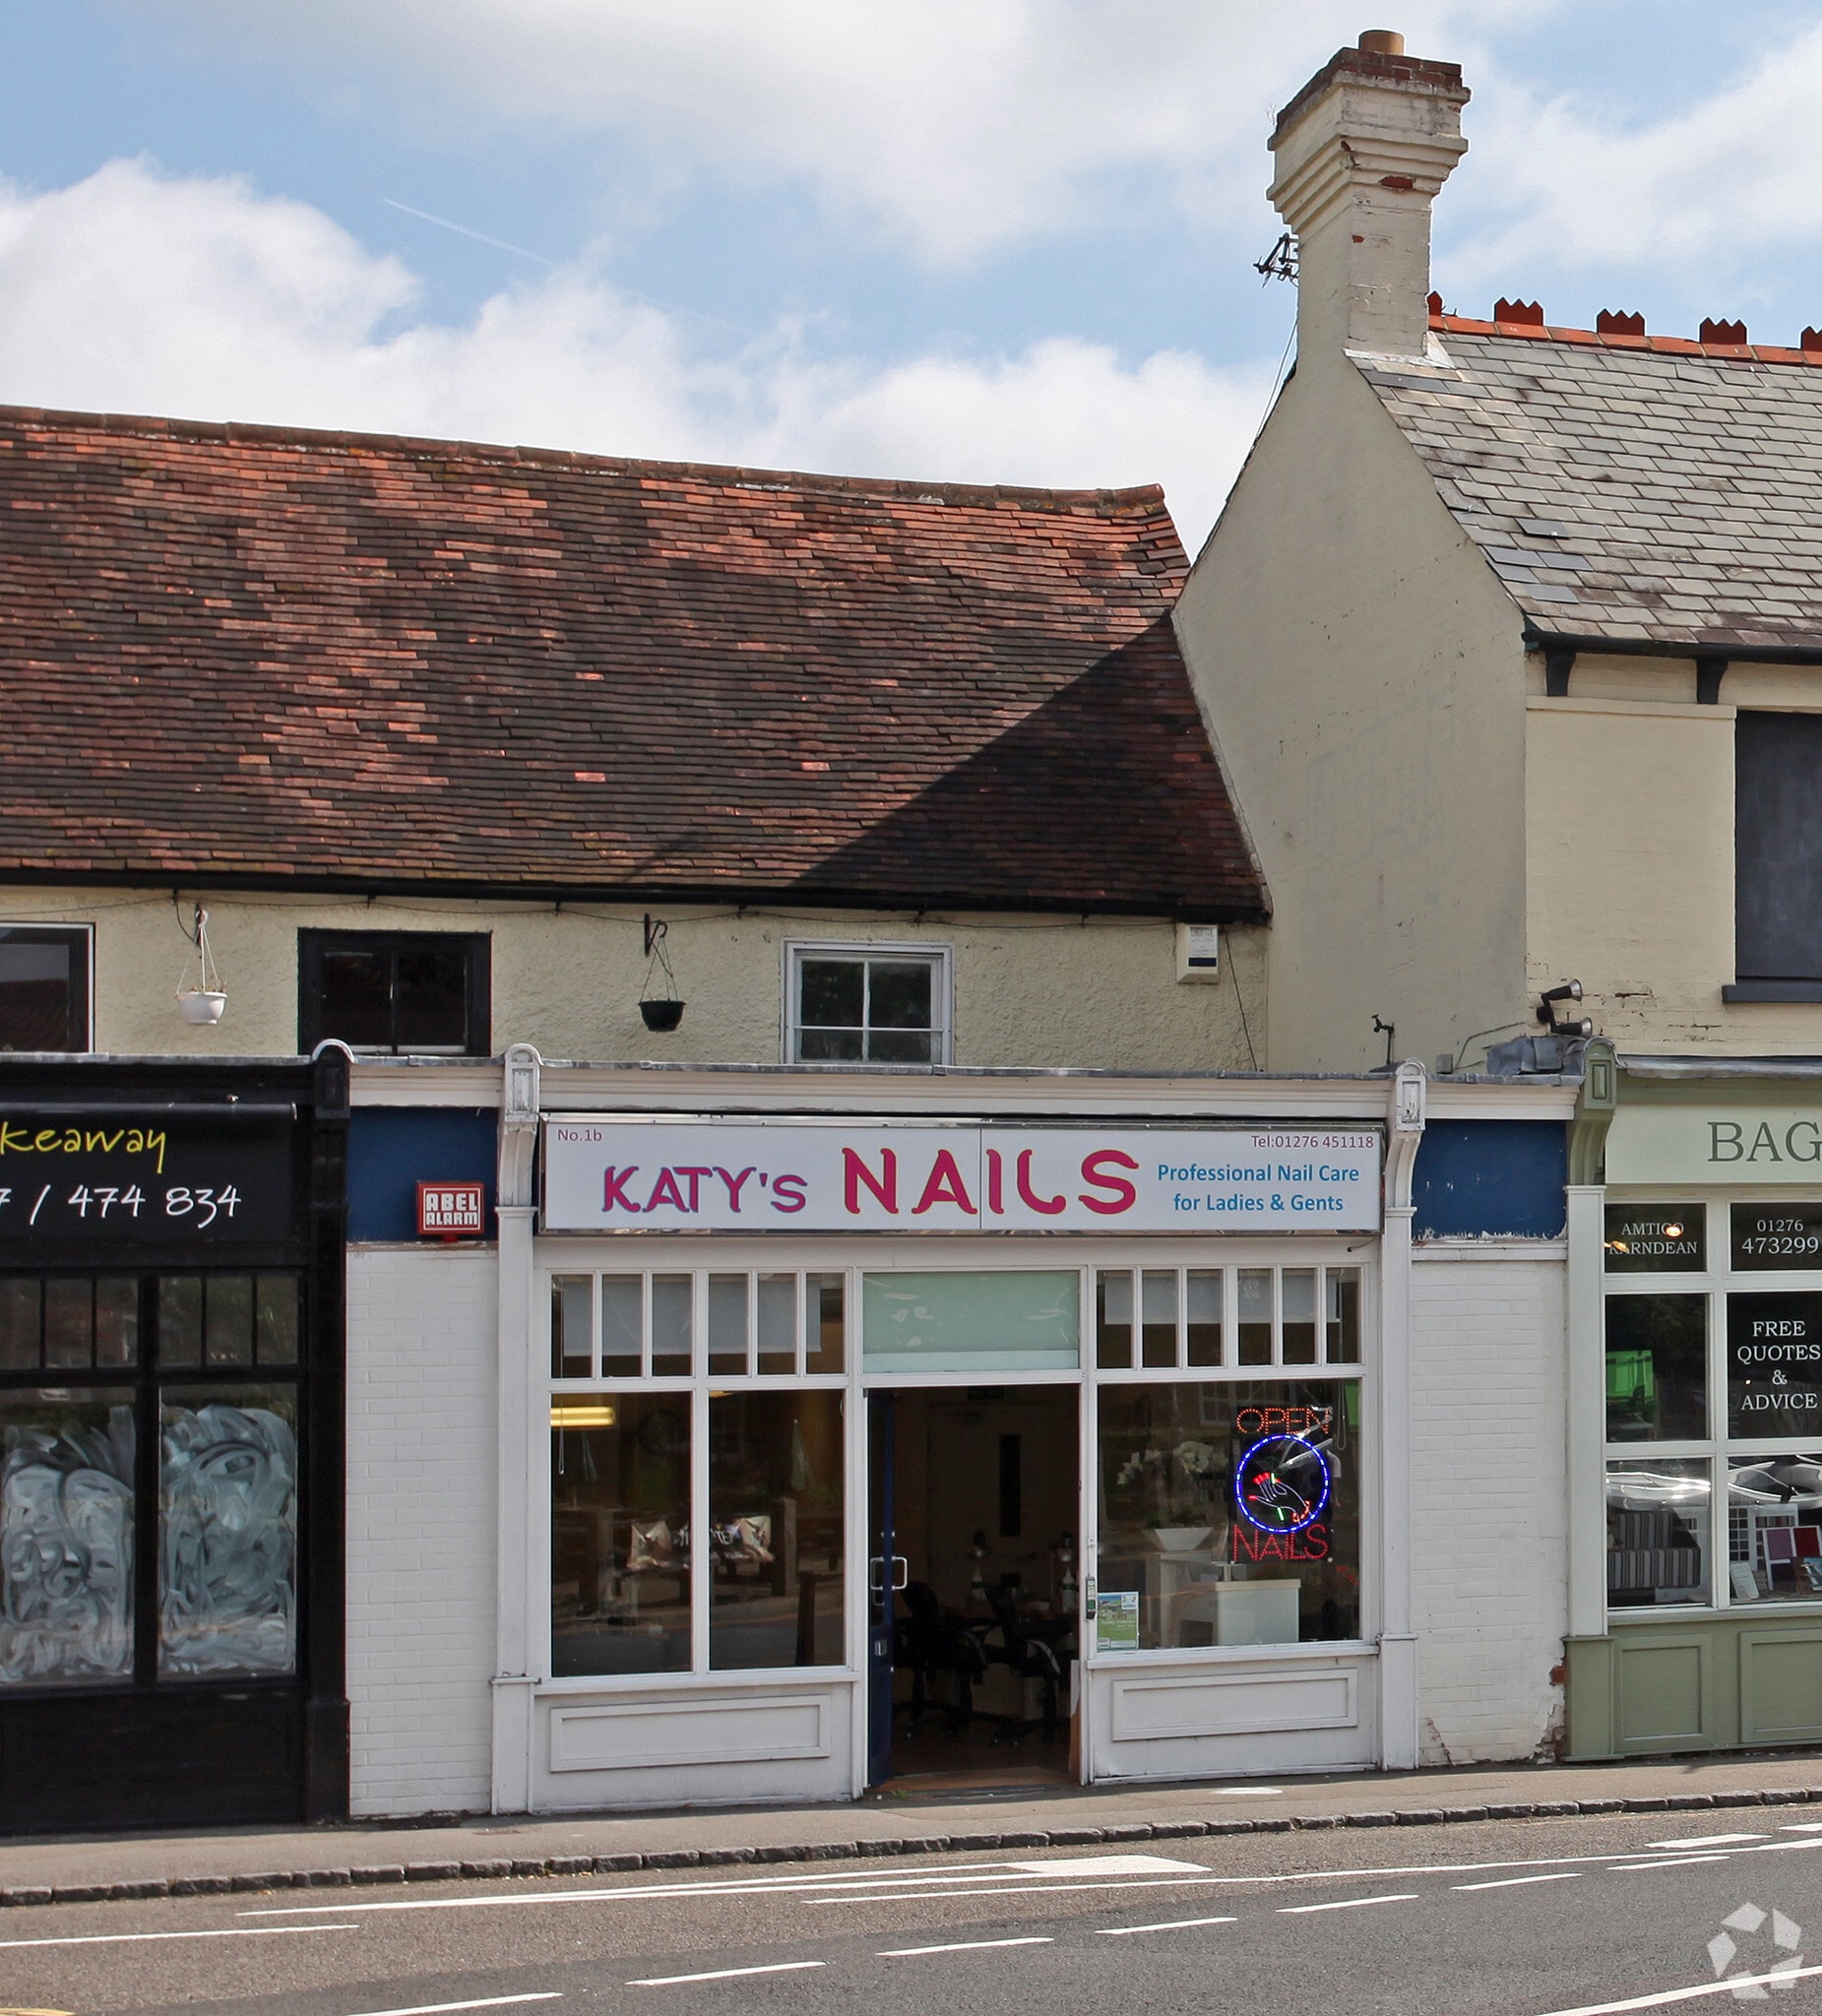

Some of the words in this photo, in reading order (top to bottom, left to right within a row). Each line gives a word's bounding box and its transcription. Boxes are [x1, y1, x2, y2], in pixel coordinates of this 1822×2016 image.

[557, 1128, 602, 1142] No.1b
[1251, 1135, 1319, 1149] Tel:01276
[1322, 1135, 1374, 1149] 451118
[1707, 1121, 1822, 1163] BAG
[0, 1121, 166, 1173] keaway
[602, 1166, 807, 1213] KATY's
[842, 1147, 1140, 1216] NAILS
[1158, 1164, 1272, 1182] Professional
[1278, 1164, 1313, 1182] Nail
[1318, 1164, 1359, 1182] Care
[68, 1184, 146, 1219] 474
[165, 1184, 242, 1228] 834
[425, 1193, 477, 1212] ABEL
[1173, 1194, 1201, 1212] for
[1206, 1194, 1264, 1212] Ladies
[1270, 1194, 1285, 1211] &
[1290, 1194, 1344, 1212] Gents
[425, 1212, 478, 1226] ALARM
[1757, 1220, 1804, 1232] 01276
[1741, 1237, 1819, 1255] 473299
[1752, 1320, 1806, 1337] FREE
[1737, 1345, 1821, 1362] QUOTES
[1772, 1369, 1788, 1385] &
[1740, 1393, 1818, 1411] ADVICE
[1236, 1408, 1330, 1434] OPEN
[1232, 1524, 1330, 1562] NAILS
